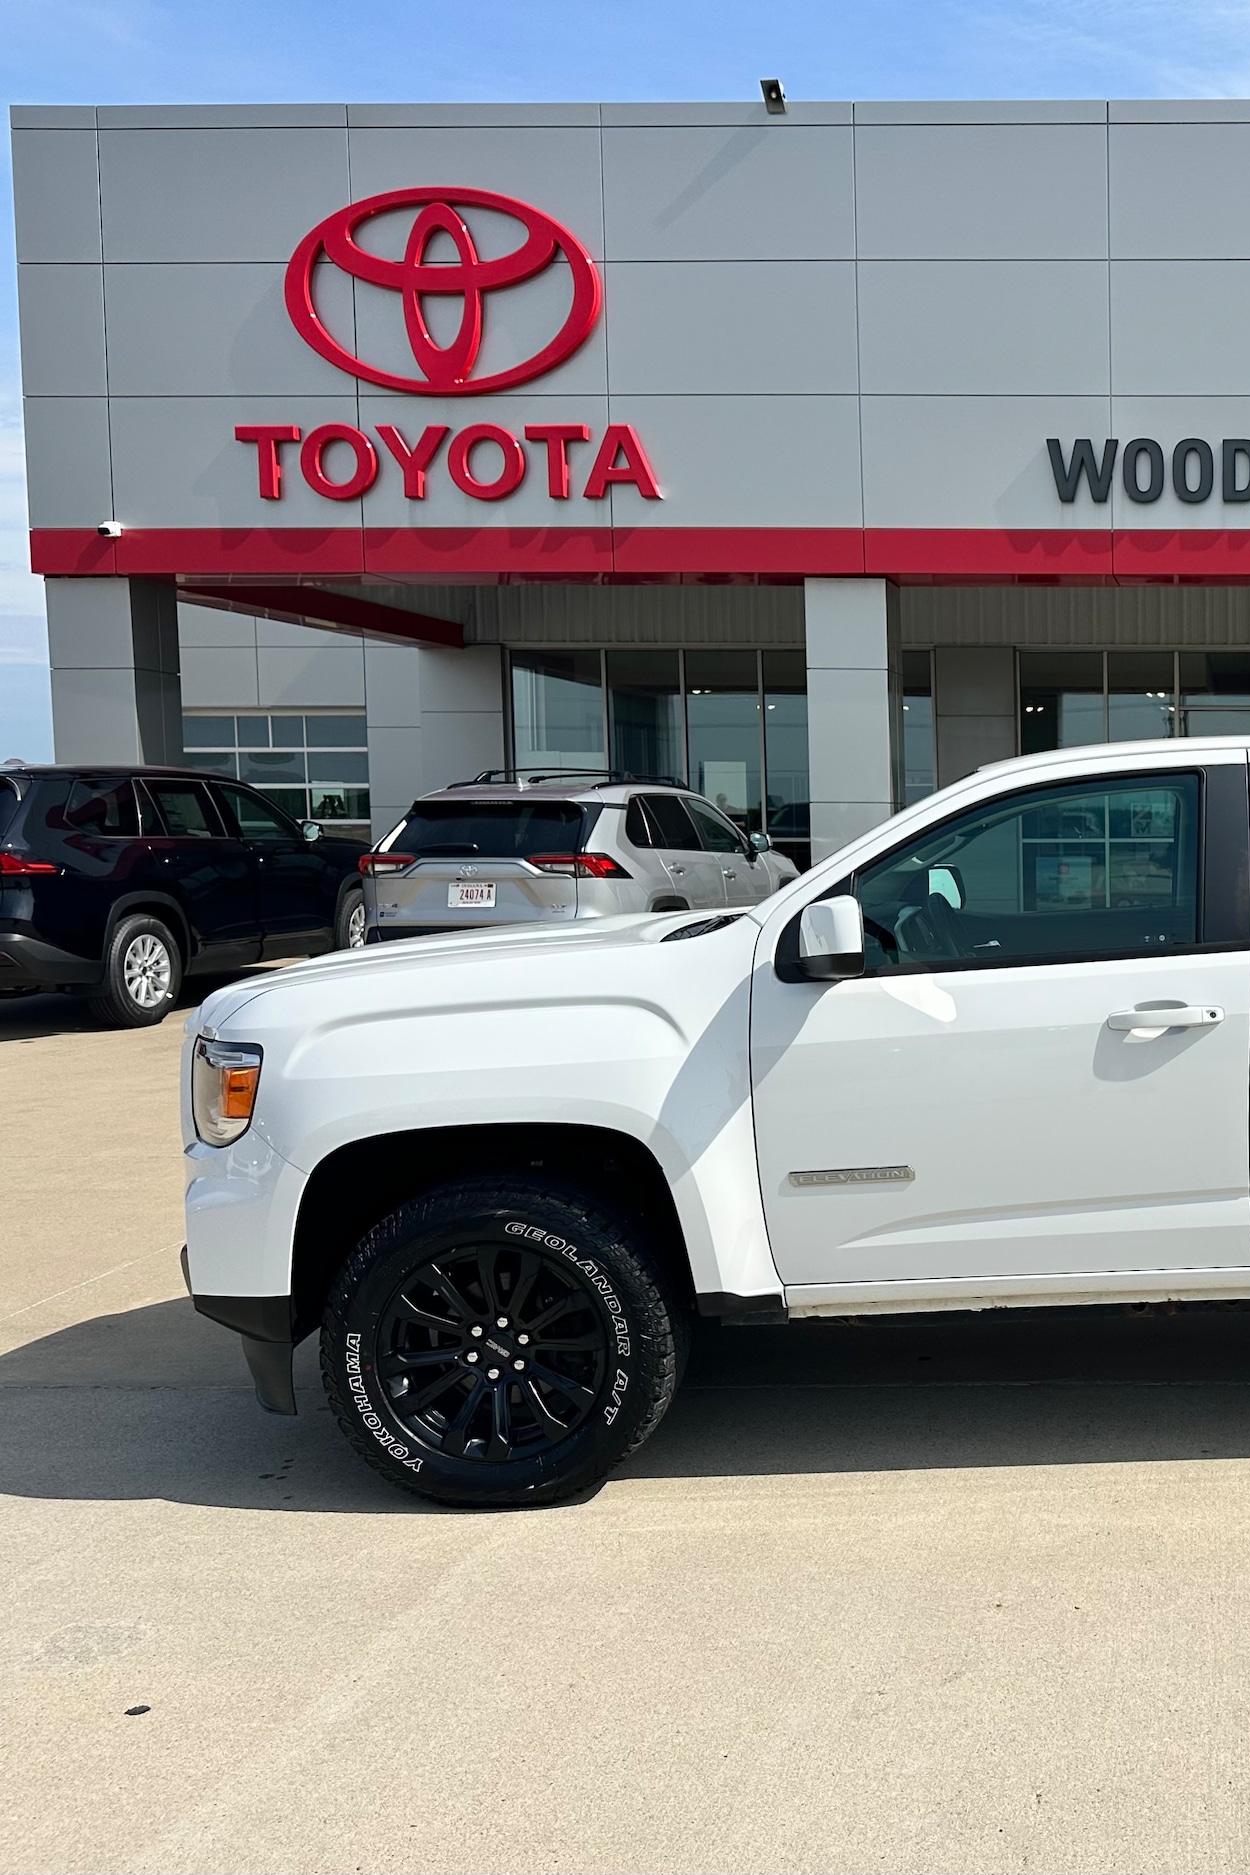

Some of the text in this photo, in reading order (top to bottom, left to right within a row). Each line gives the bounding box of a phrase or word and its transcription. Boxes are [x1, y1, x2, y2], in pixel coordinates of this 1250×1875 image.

[235, 423, 664, 500] TOYOTA
[459, 889, 484, 900] 24074
[799, 1170, 905, 1182] ELEVATION
[504, 1222, 630, 1426] GEOLANDAR A/T
[346, 1333, 425, 1472] YOKOHAMA
